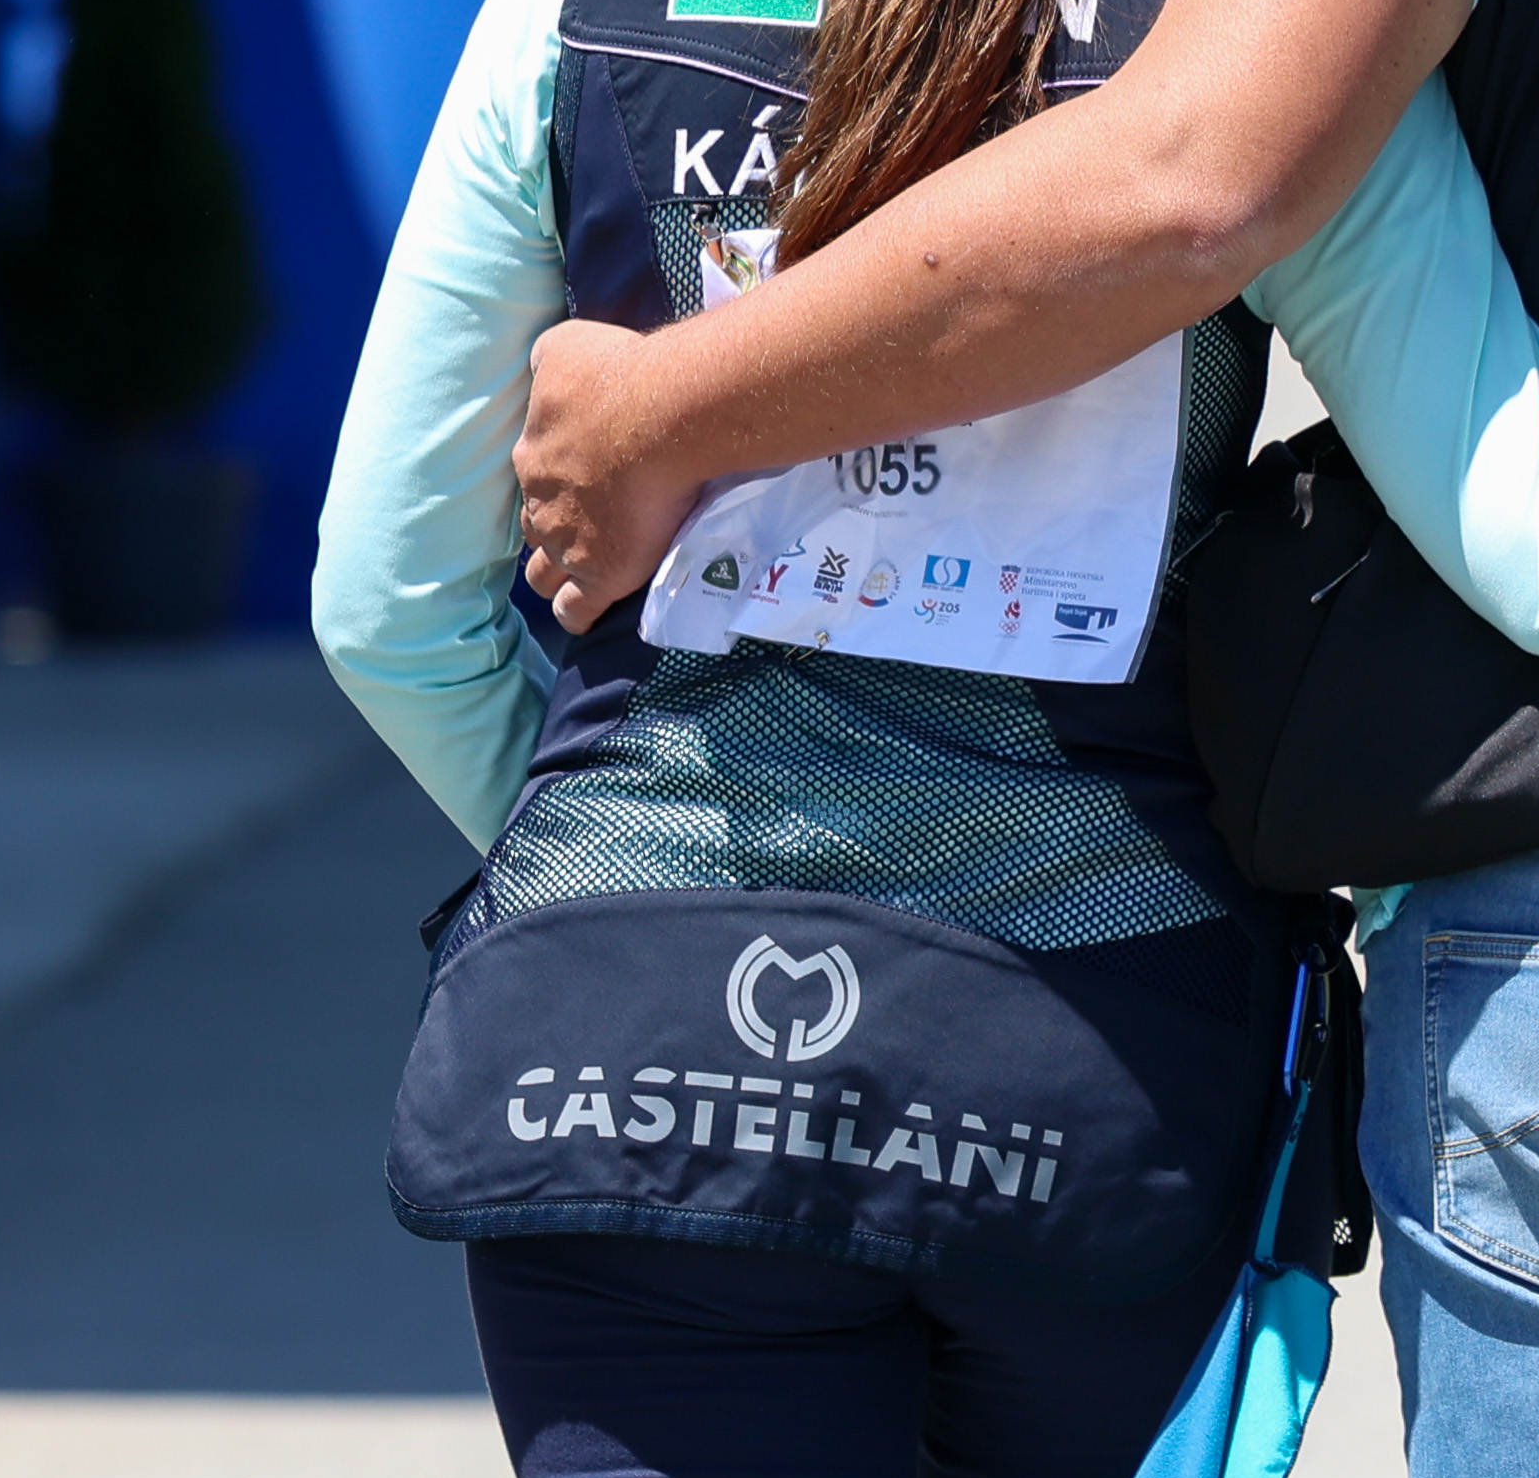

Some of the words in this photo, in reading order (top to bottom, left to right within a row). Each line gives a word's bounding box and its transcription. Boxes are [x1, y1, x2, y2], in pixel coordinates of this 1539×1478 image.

[672, 105, 805, 197] KÁ
[828, 443, 941, 496] 1055
[1021, 587, 1054, 598] turizma
[1060, 591, 1087, 602] sporta
[1024, 576, 1077, 590] Ministarstvo
[938, 602, 960, 614] ZOS
[507, 1066, 1064, 1203] CASTELLANI
